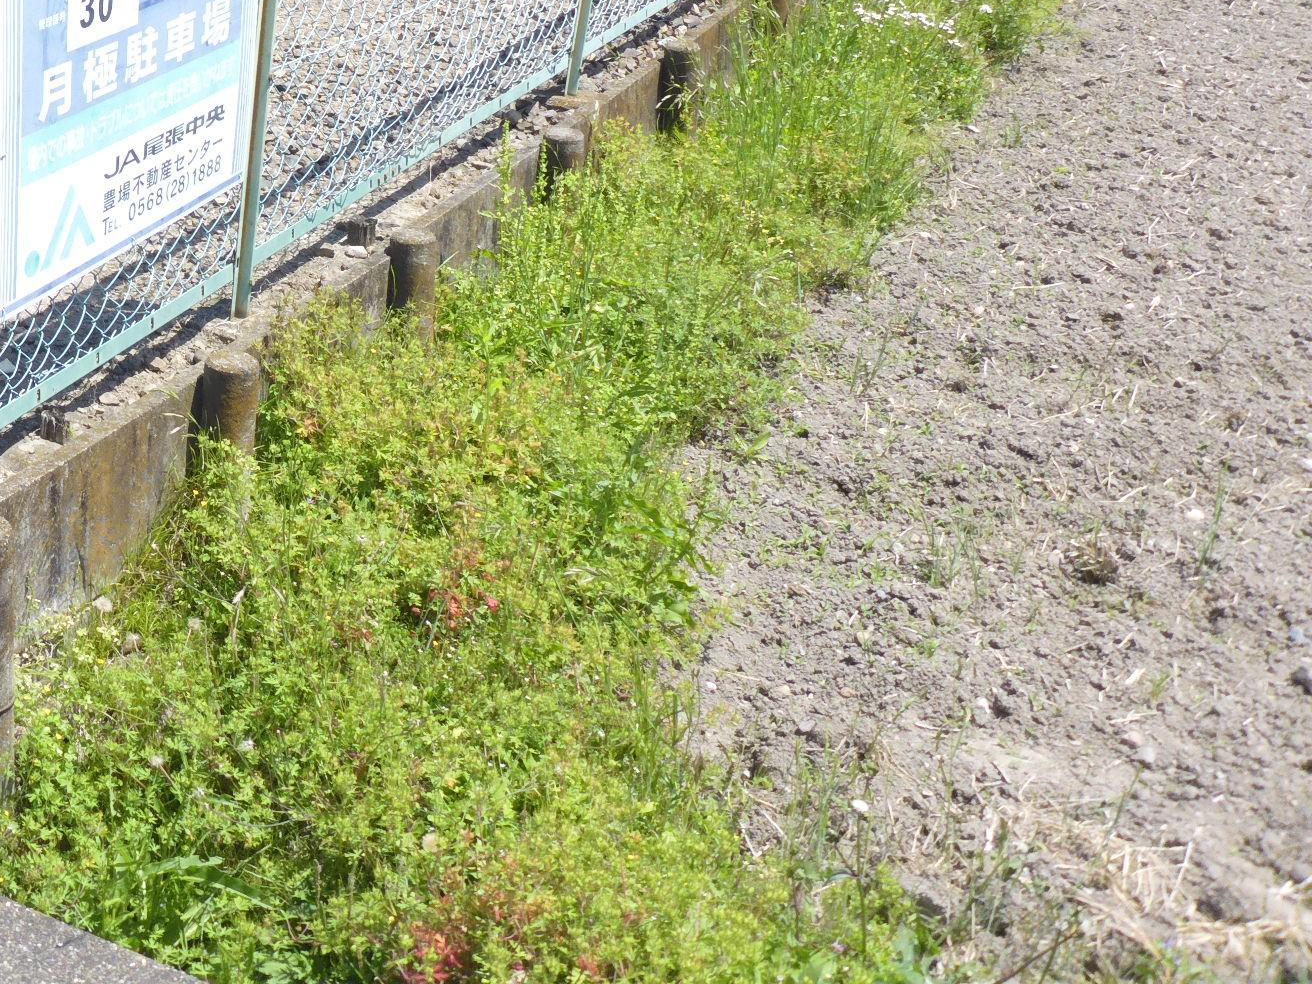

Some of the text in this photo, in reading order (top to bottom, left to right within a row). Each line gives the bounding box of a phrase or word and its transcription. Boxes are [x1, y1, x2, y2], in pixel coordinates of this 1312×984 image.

[103, 138, 223, 213] 豊場不動産センター
[104, 104, 225, 179] JA尾張中央
[128, 155, 222, 221] 0568(28)1888
